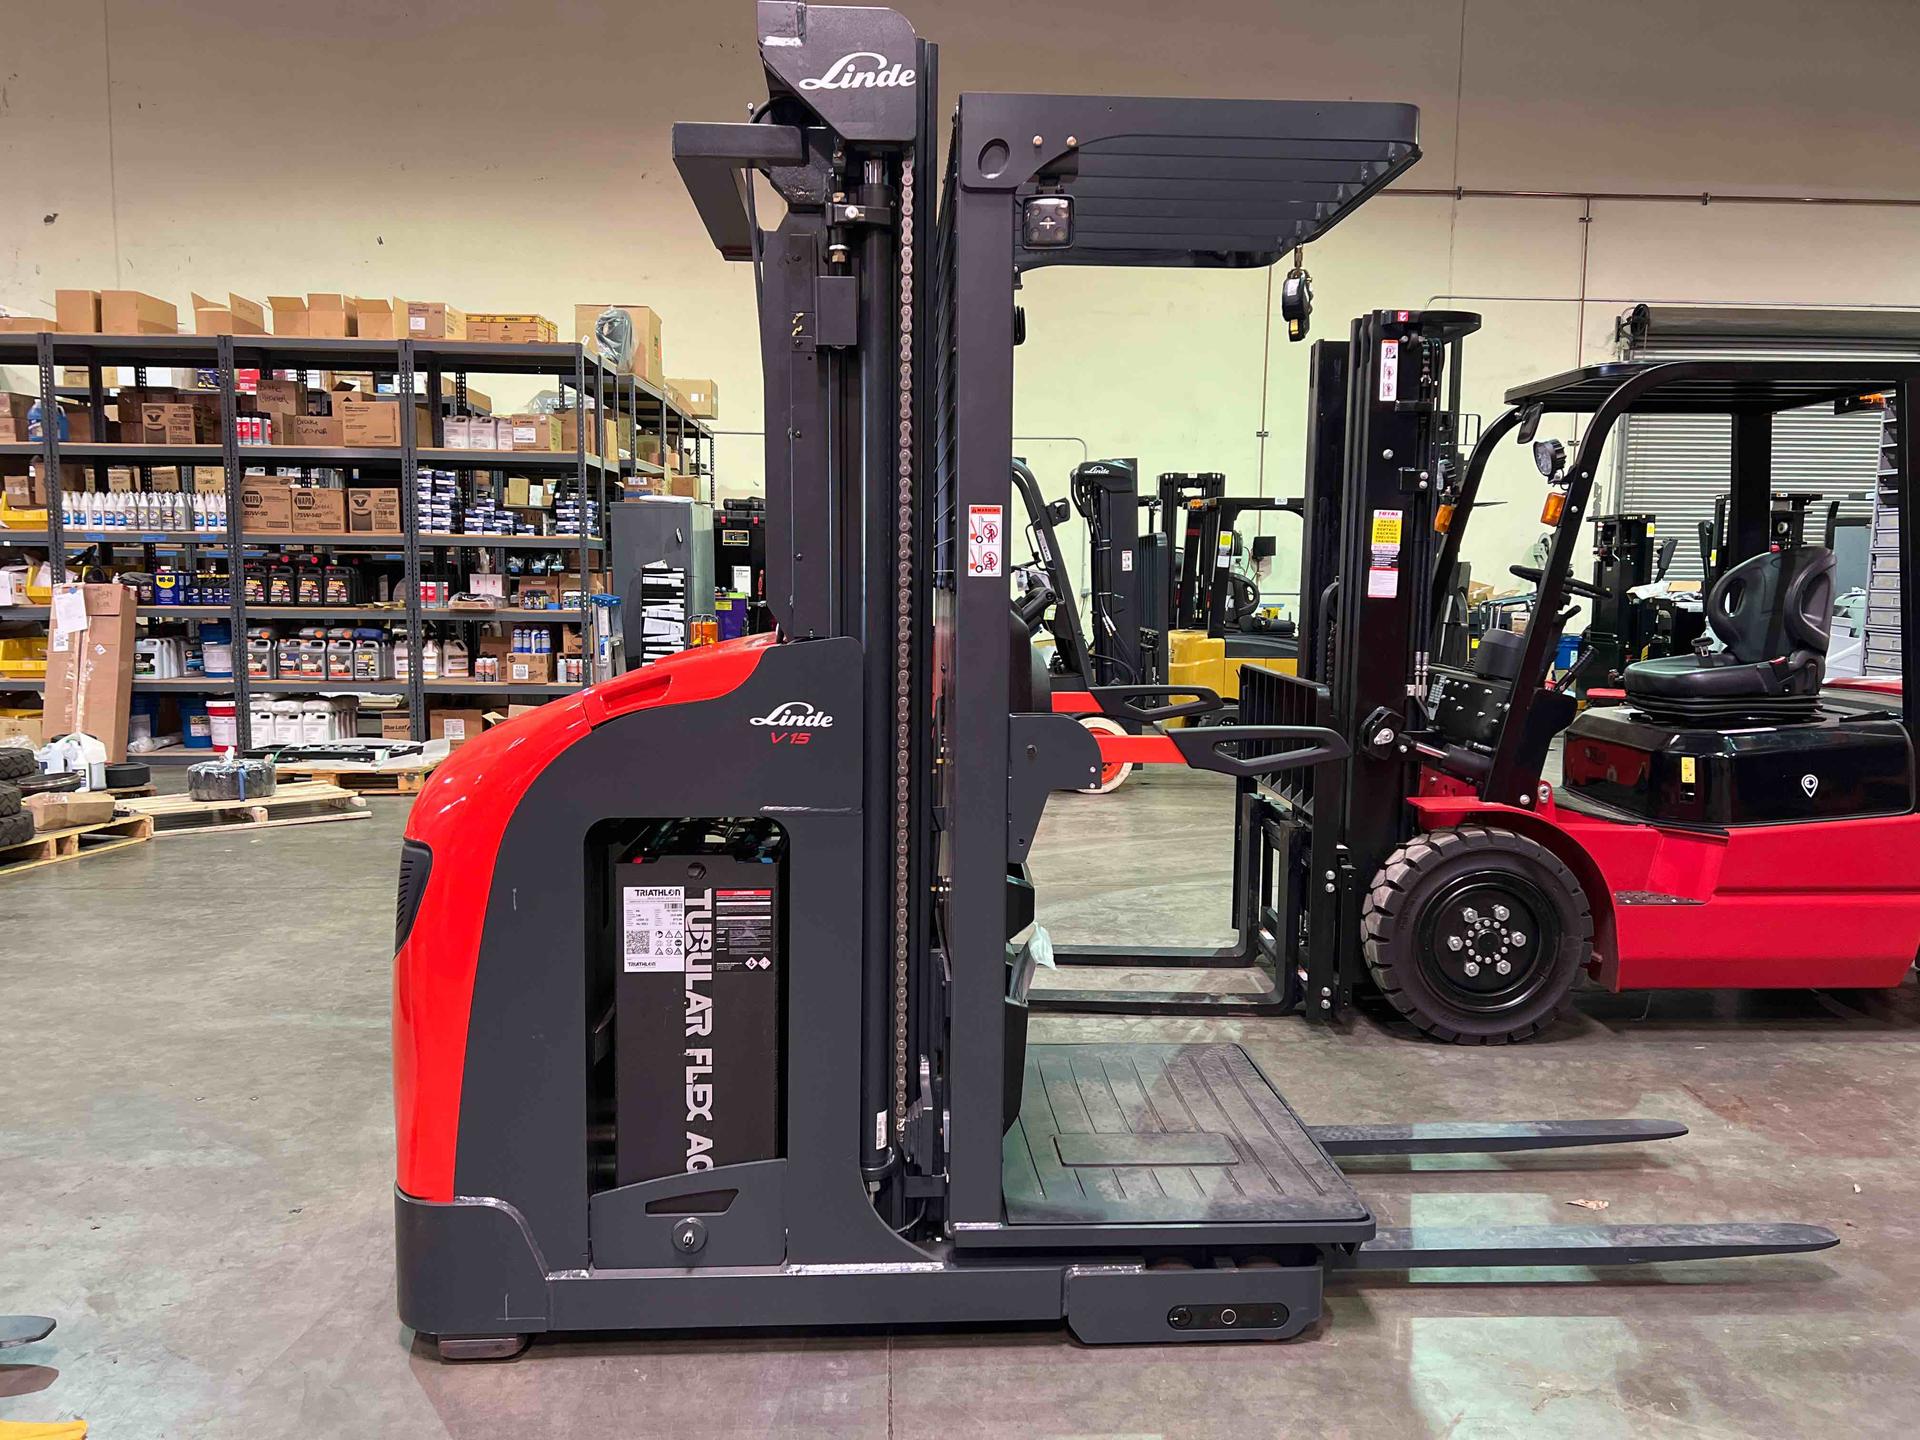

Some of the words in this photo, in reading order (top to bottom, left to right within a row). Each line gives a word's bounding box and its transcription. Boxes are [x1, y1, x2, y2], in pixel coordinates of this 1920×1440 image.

[799, 51, 916, 90] Linde
[1084, 466, 1110, 474] Linde
[244, 494, 260, 504] NAPA
[297, 497, 312, 507] NAPA
[750, 701, 833, 727] Linde
[635, 889, 681, 897] TRIATHLON
[685, 888, 713, 1037] TUBULAR
[686, 1048, 713, 1122] FLEX
